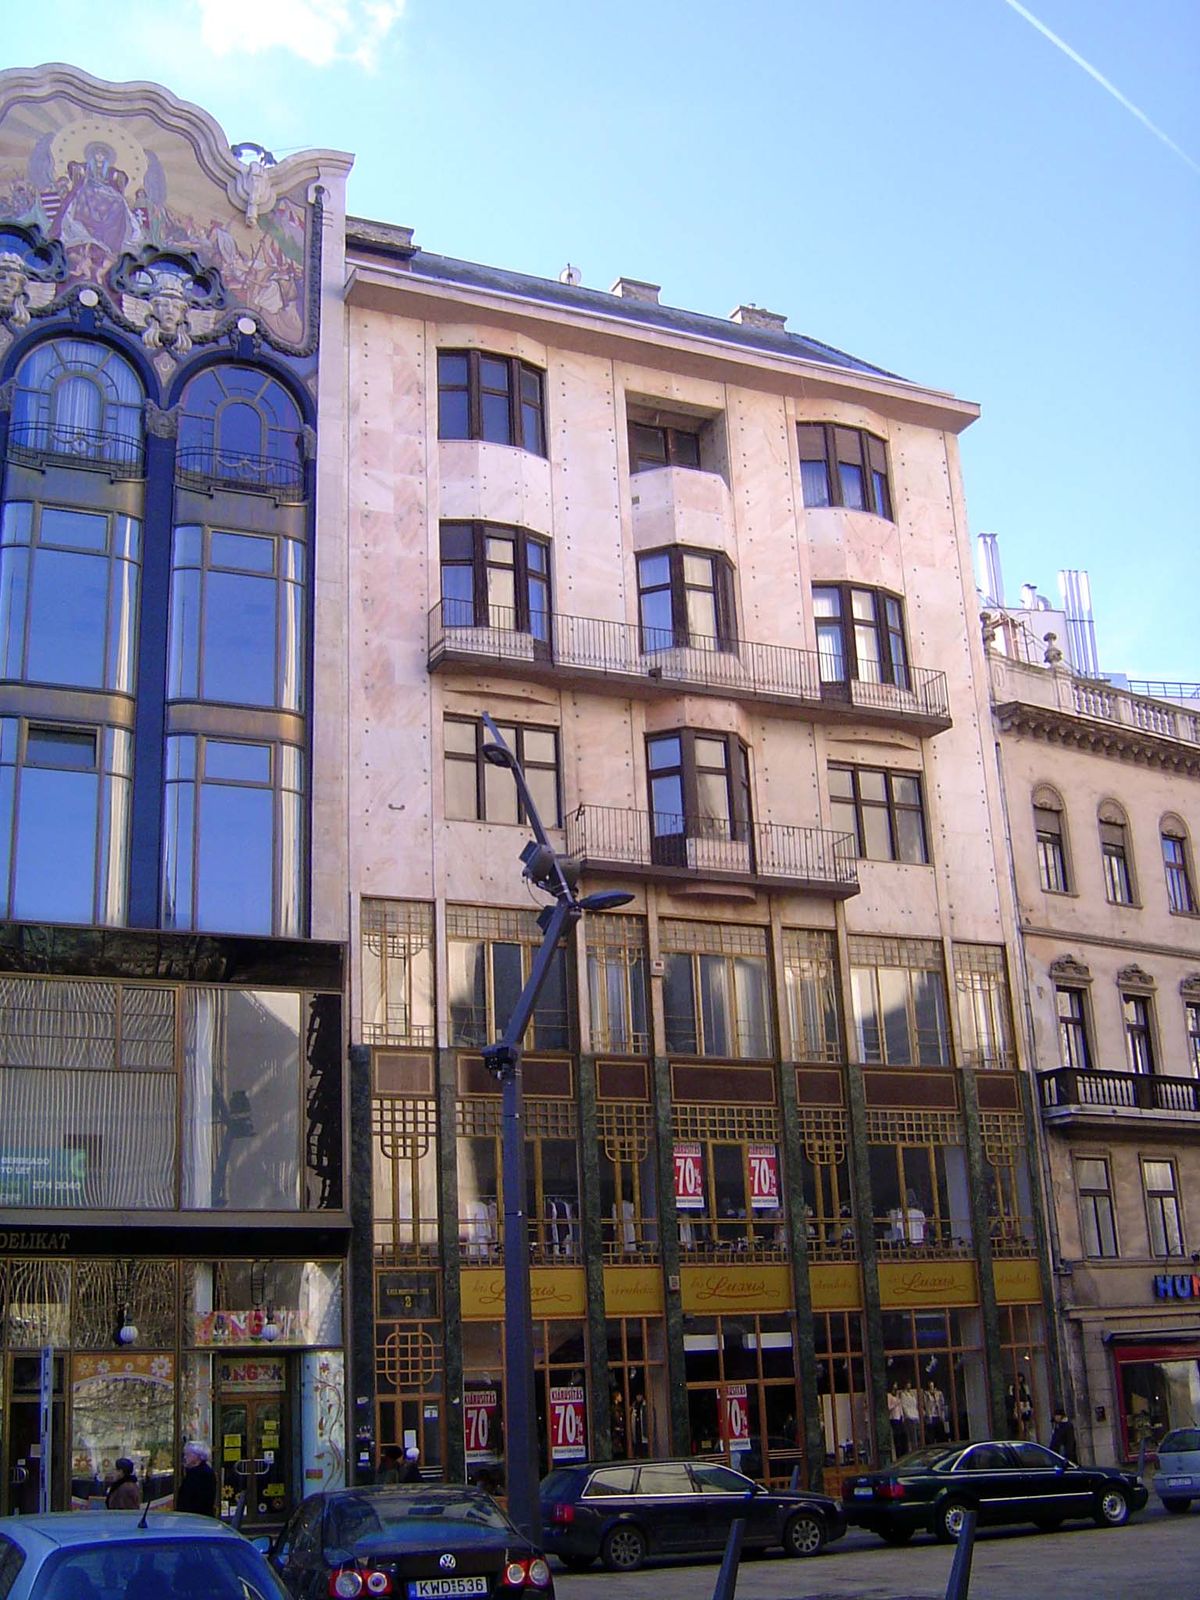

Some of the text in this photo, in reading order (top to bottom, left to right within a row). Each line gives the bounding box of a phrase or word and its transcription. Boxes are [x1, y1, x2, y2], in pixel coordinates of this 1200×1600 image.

[0, 1232, 70, 1249] DELIKAT
[702, 1276, 768, 1298] Luxus
[899, 1272, 958, 1291] Luxus
